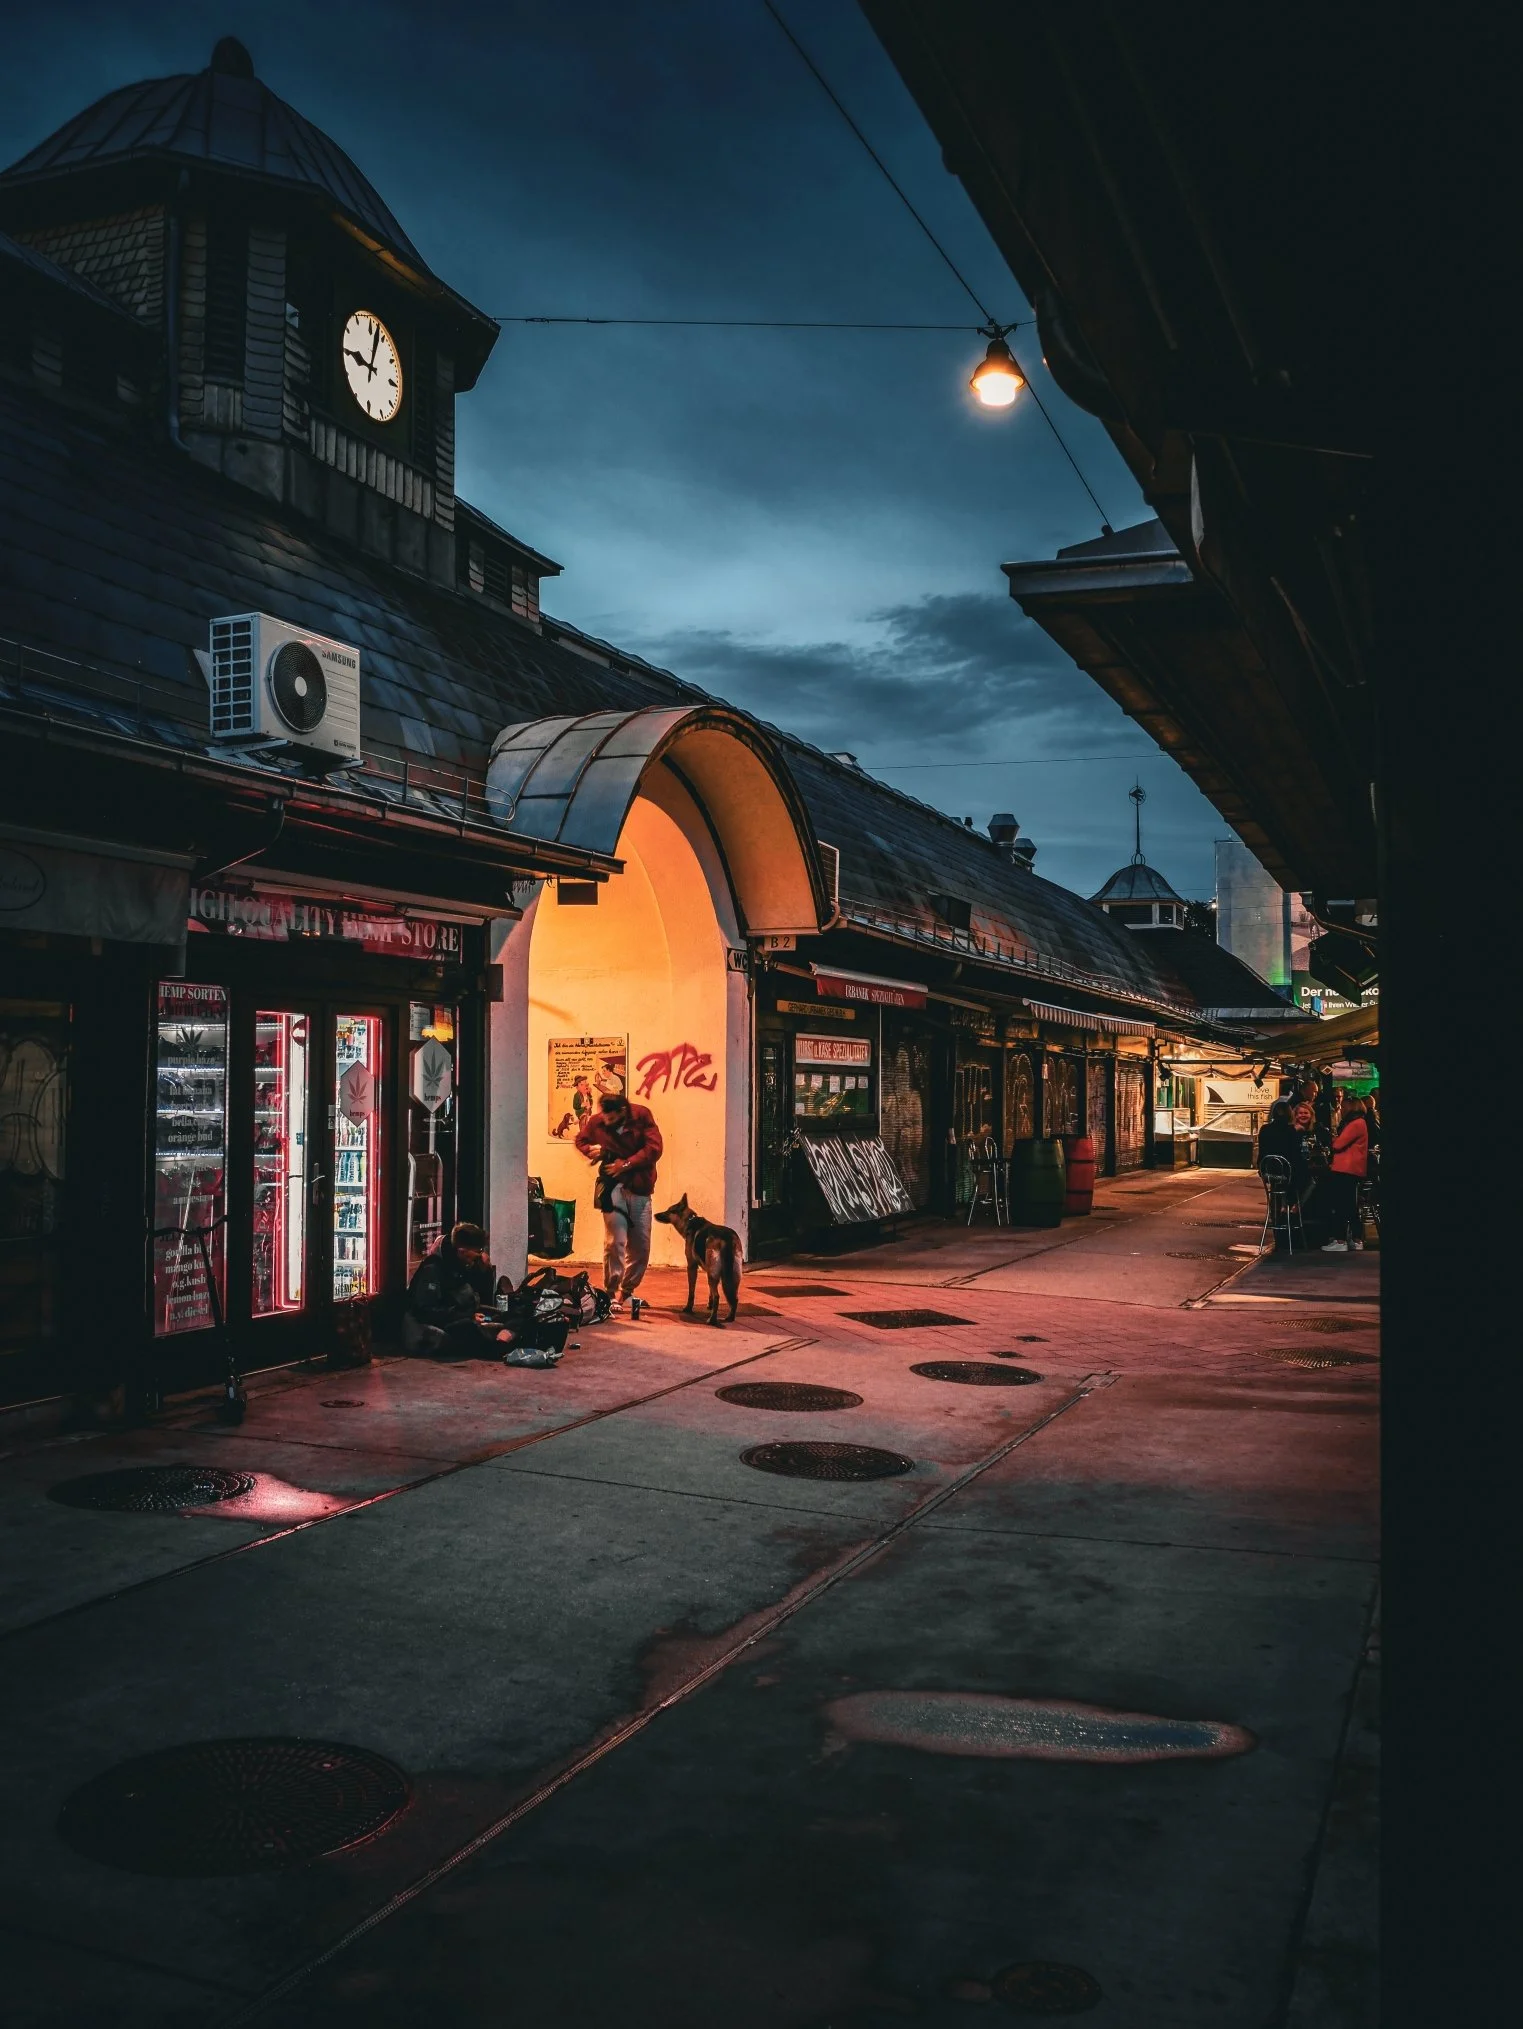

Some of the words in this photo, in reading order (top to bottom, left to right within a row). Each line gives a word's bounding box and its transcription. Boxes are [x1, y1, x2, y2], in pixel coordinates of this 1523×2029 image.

[322, 649, 356, 669] SAMSUNG
[189, 887, 240, 923] IGH
[402, 922, 459, 952] STORE
[771, 936, 779, 949] B
[784, 936, 791, 948] 2
[734, 952, 749, 970] WC
[160, 985, 187, 999] HEMP
[187, 986, 227, 1001] SORTEN
[845, 984, 869, 1001] URBANEK
[1301, 986, 1323, 997] Der
[1254, 1086, 1270, 1094] love
[423, 1093, 441, 1103] hemps
[350, 1109, 365, 1119] hemps
[168, 1132, 196, 1144] orange
[197, 1130, 213, 1142] bud
[193, 1260, 214, 1270] kuh
